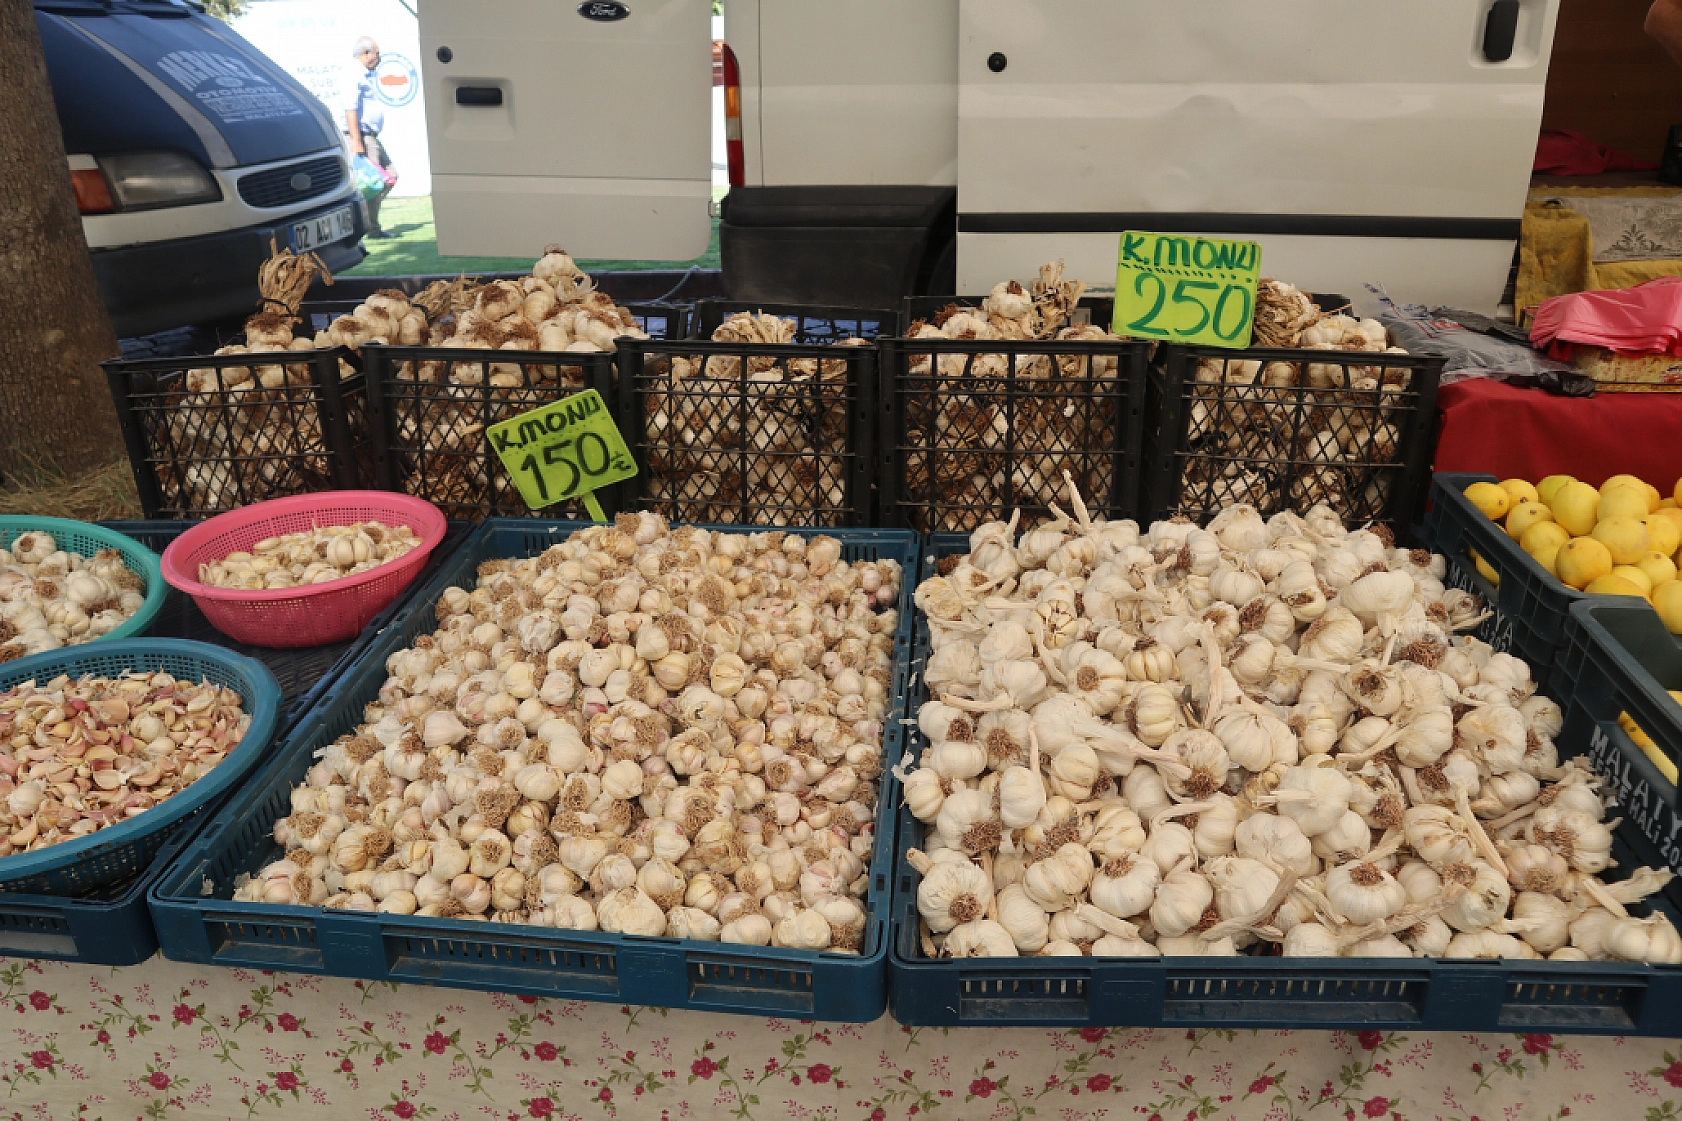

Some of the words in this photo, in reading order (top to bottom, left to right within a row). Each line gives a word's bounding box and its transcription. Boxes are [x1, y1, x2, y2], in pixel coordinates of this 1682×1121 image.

[589, 2, 617, 16] Ford
[295, 224, 310, 250] 02
[1126, 272, 1251, 341] 250
[520, 432, 611, 501] 150
